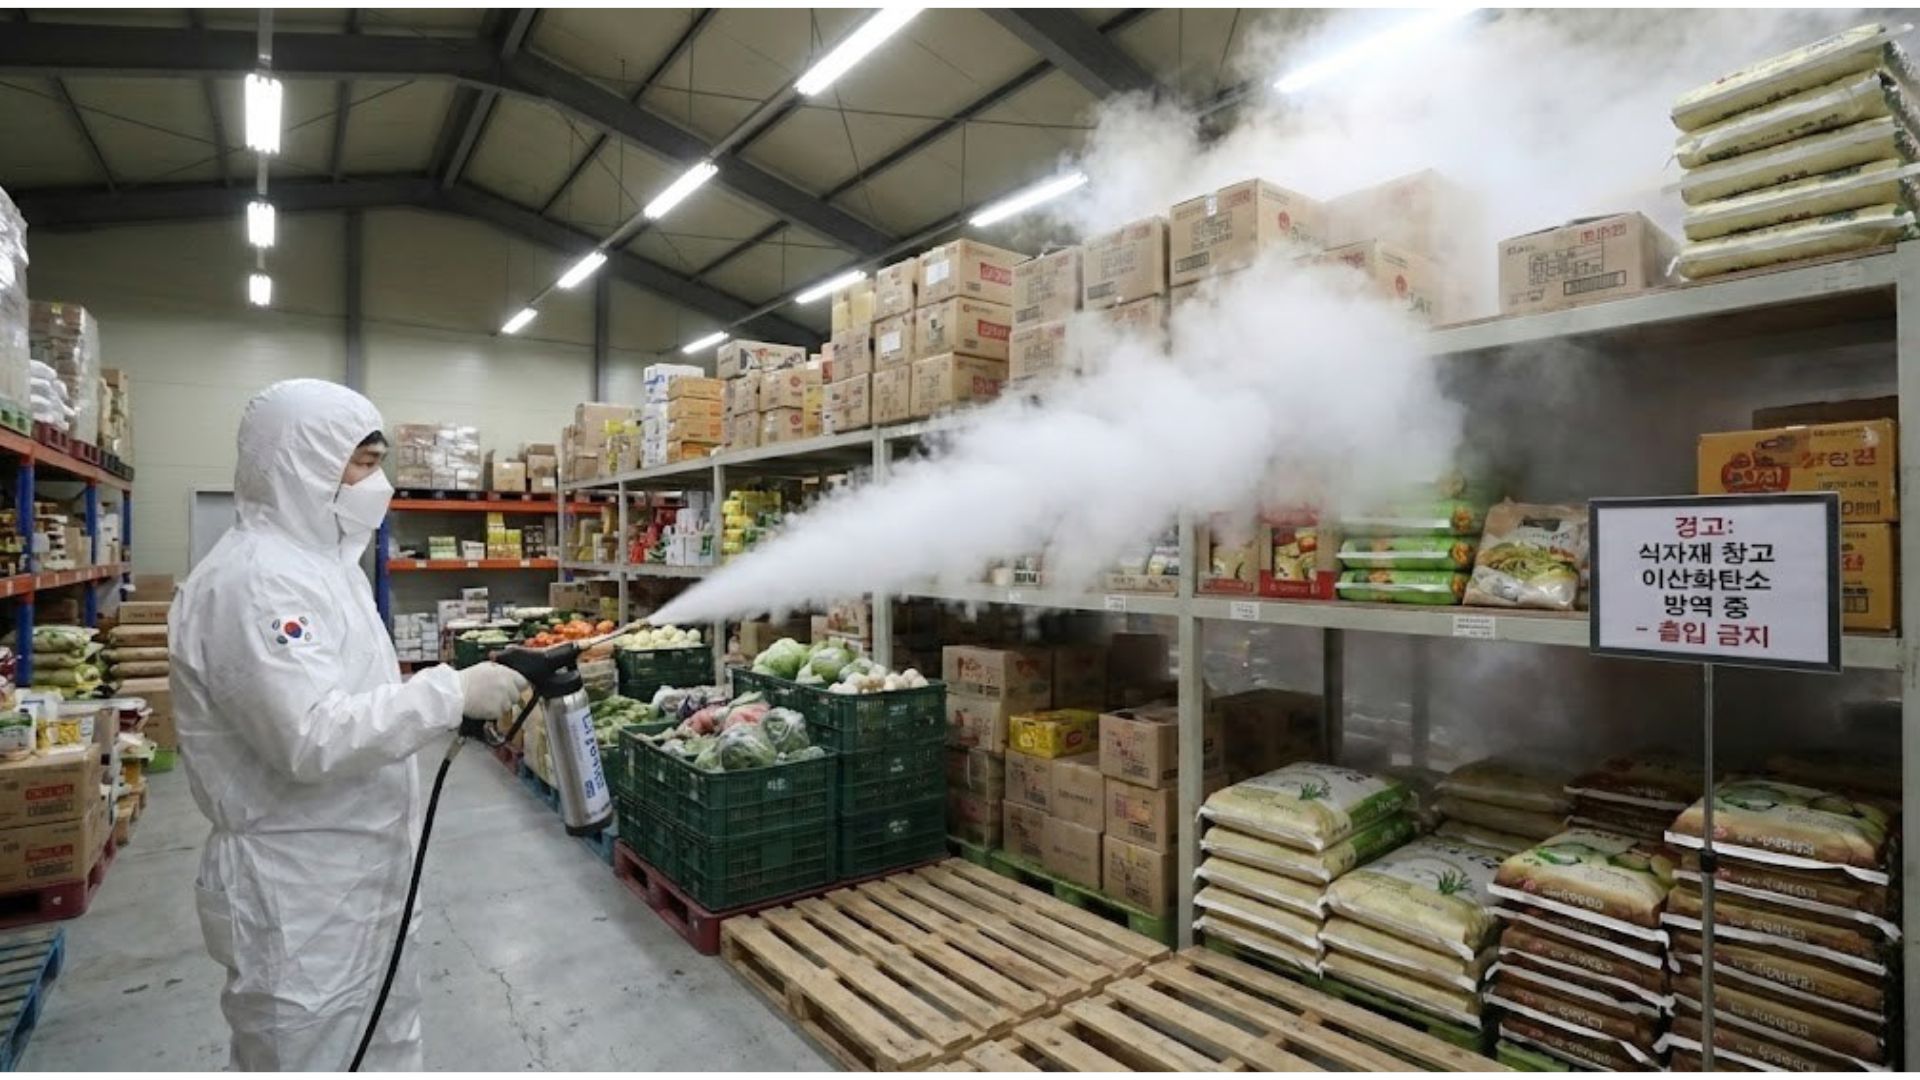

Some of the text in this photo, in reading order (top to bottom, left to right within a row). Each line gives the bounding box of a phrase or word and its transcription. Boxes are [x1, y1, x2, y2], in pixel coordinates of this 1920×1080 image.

[1675, 516, 1733, 538] 경고:
[1638, 542, 1775, 565] 식자재 창고
[1642, 568, 1772, 591] 이산화탄소
[1664, 594, 1749, 619] 방역 중
[1717, 623, 1769, 648] 금지
